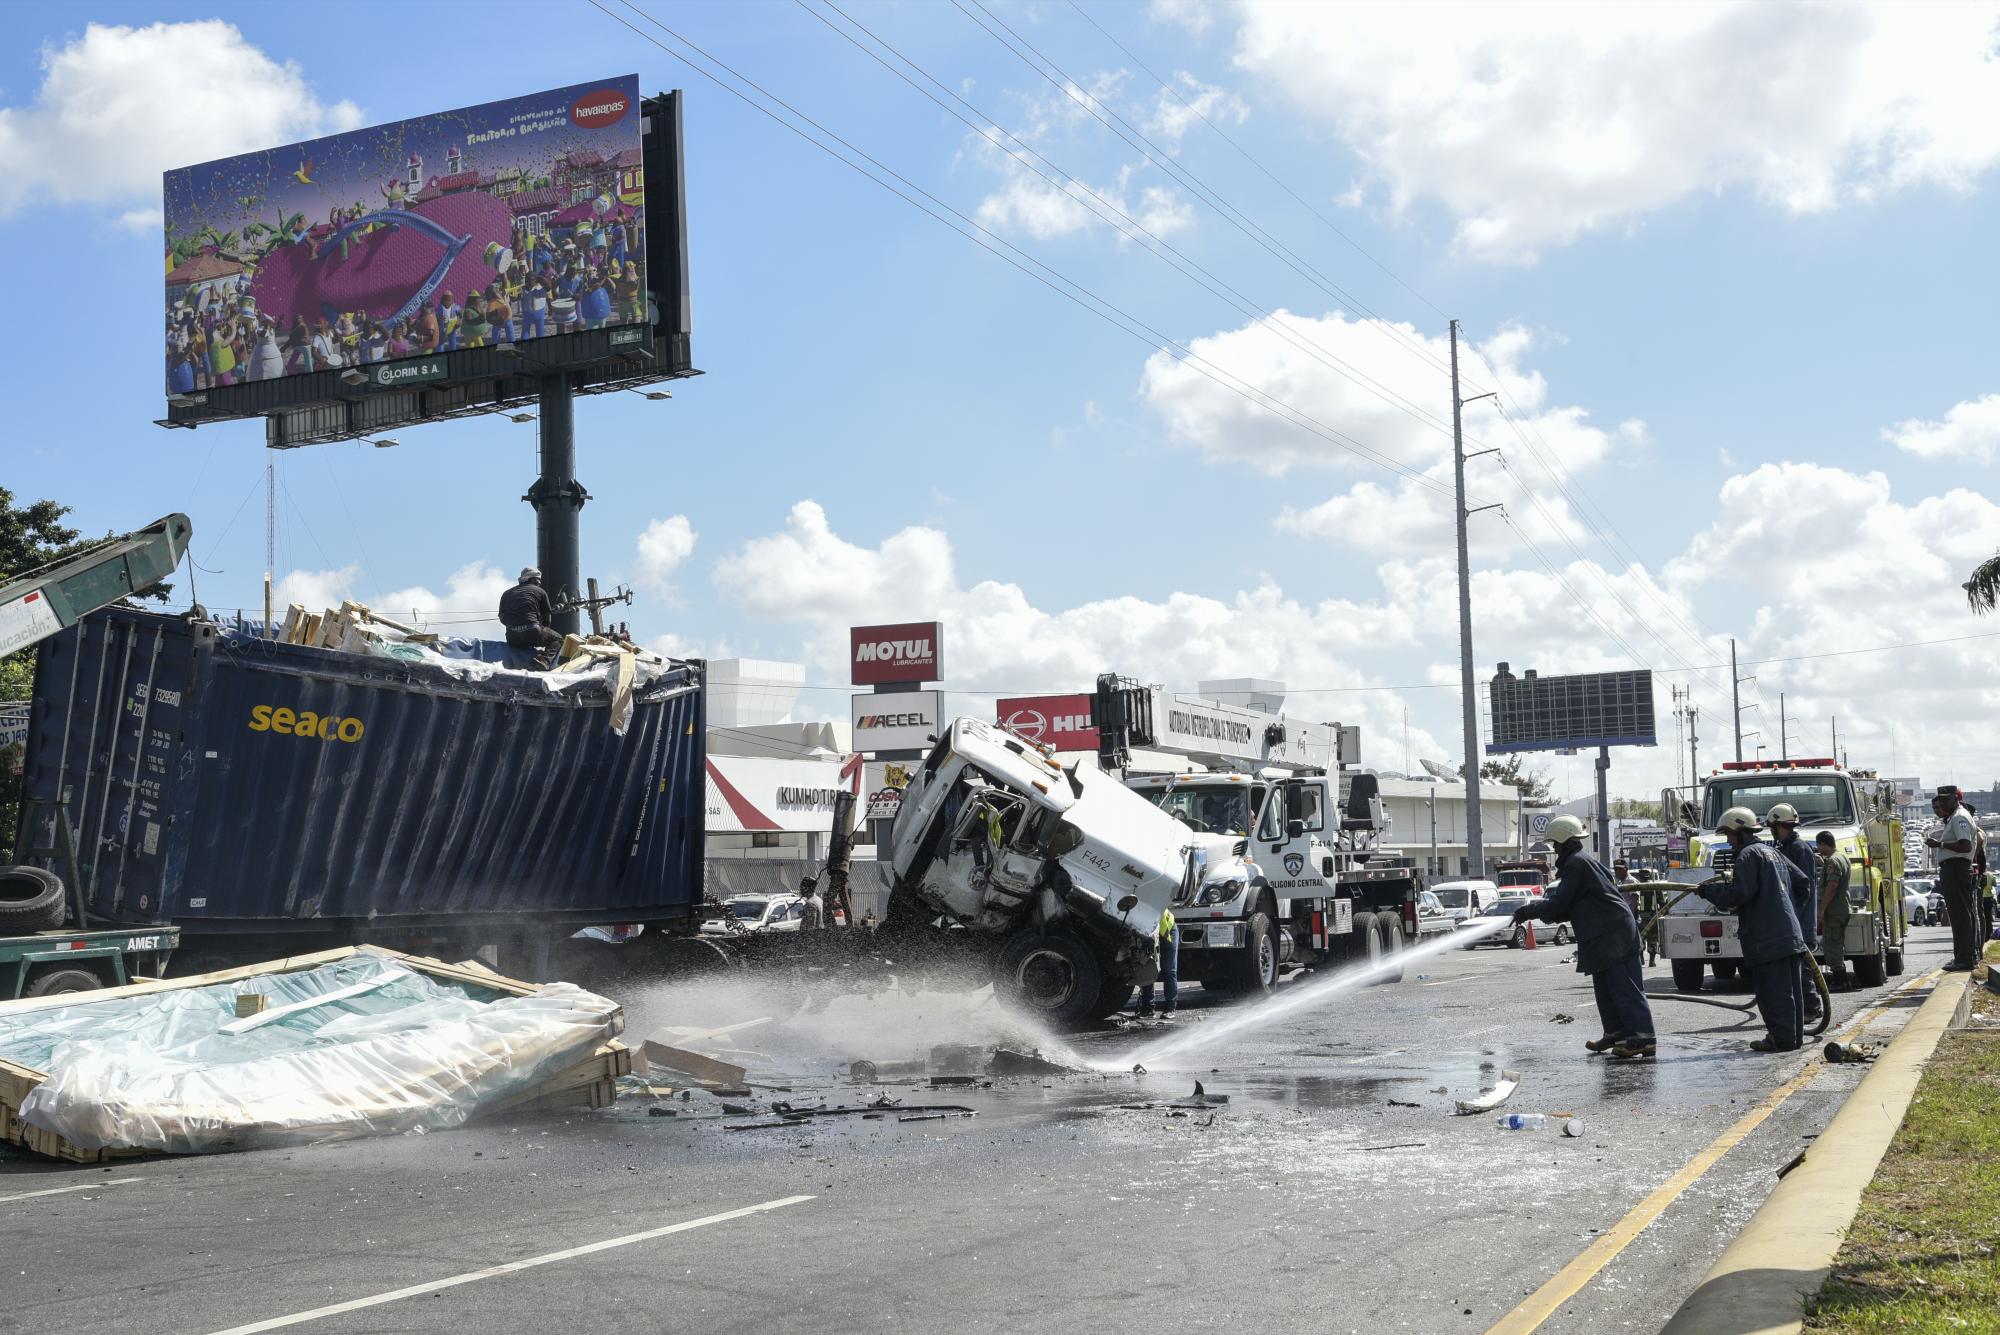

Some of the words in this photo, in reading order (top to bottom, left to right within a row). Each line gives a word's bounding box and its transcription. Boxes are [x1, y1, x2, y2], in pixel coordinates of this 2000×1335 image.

[557, 106, 566, 116] AL
[576, 101, 625, 118] havaianas
[378, 365, 418, 385] COLORIN
[856, 639, 932, 661] MOTUL
[893, 658, 933, 666] LUBRICANTES
[248, 704, 365, 743] seaco
[780, 786, 818, 805] KUMHO
[1082, 849, 1111, 873] F442
[1297, 878, 1323, 888] CENTRAL
[127, 935, 160, 950] AMET
